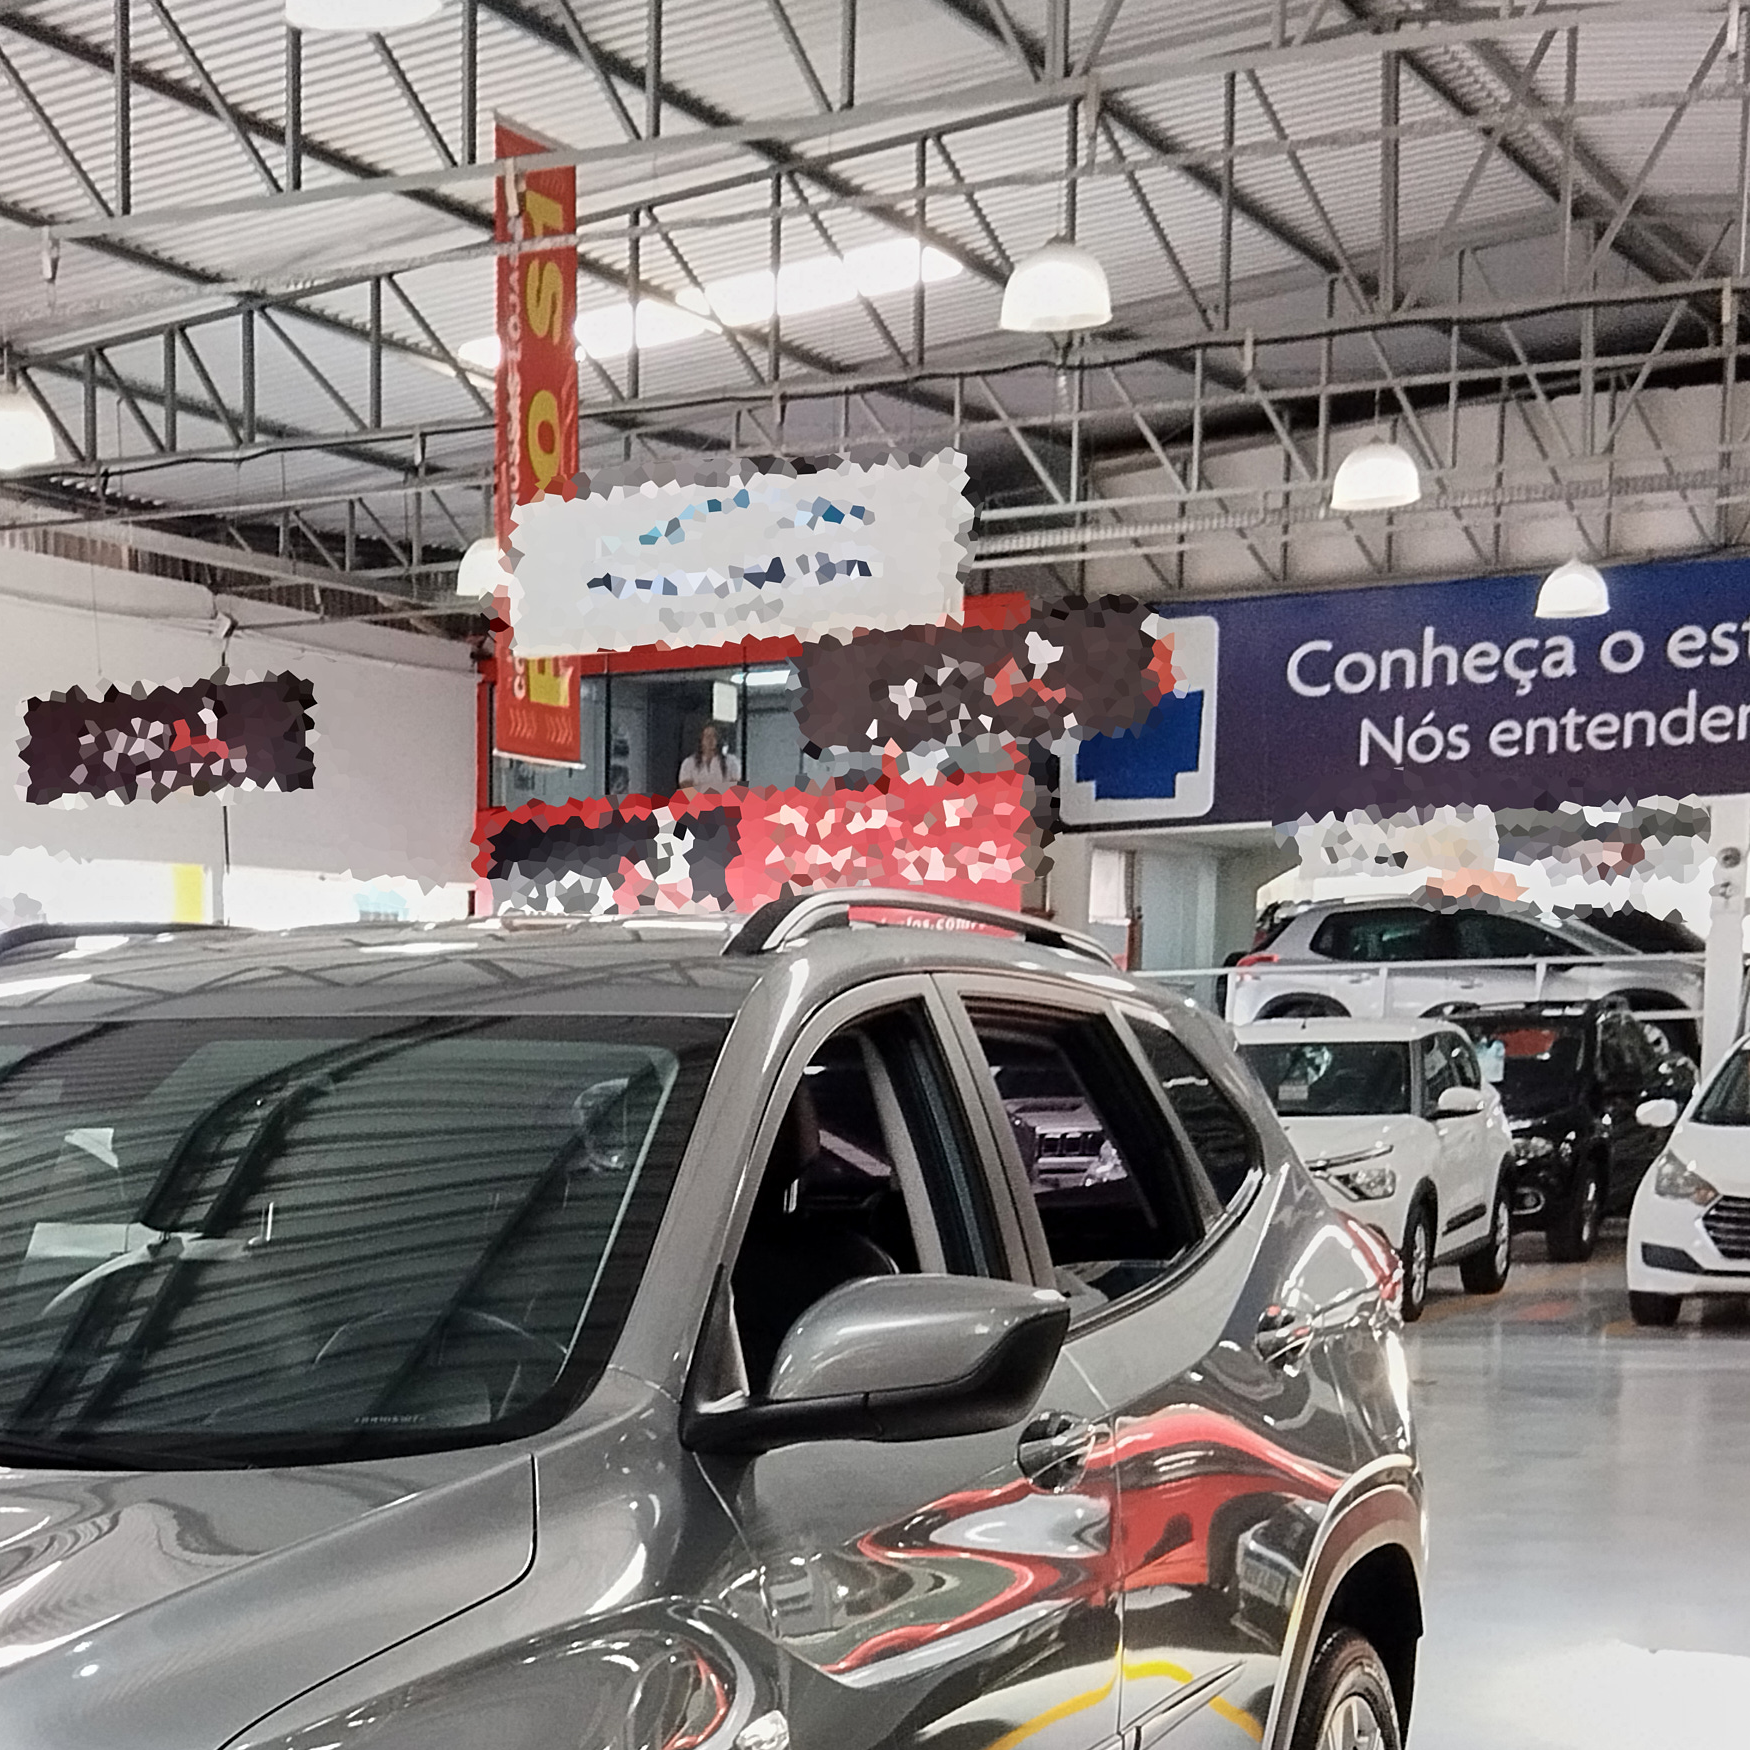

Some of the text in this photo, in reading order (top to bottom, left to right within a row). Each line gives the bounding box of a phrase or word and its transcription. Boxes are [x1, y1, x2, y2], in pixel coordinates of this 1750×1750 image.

[1286, 625, 1577, 697] Conheça
[1600, 629, 1645, 674] o
[1359, 709, 1471, 767] Nós
